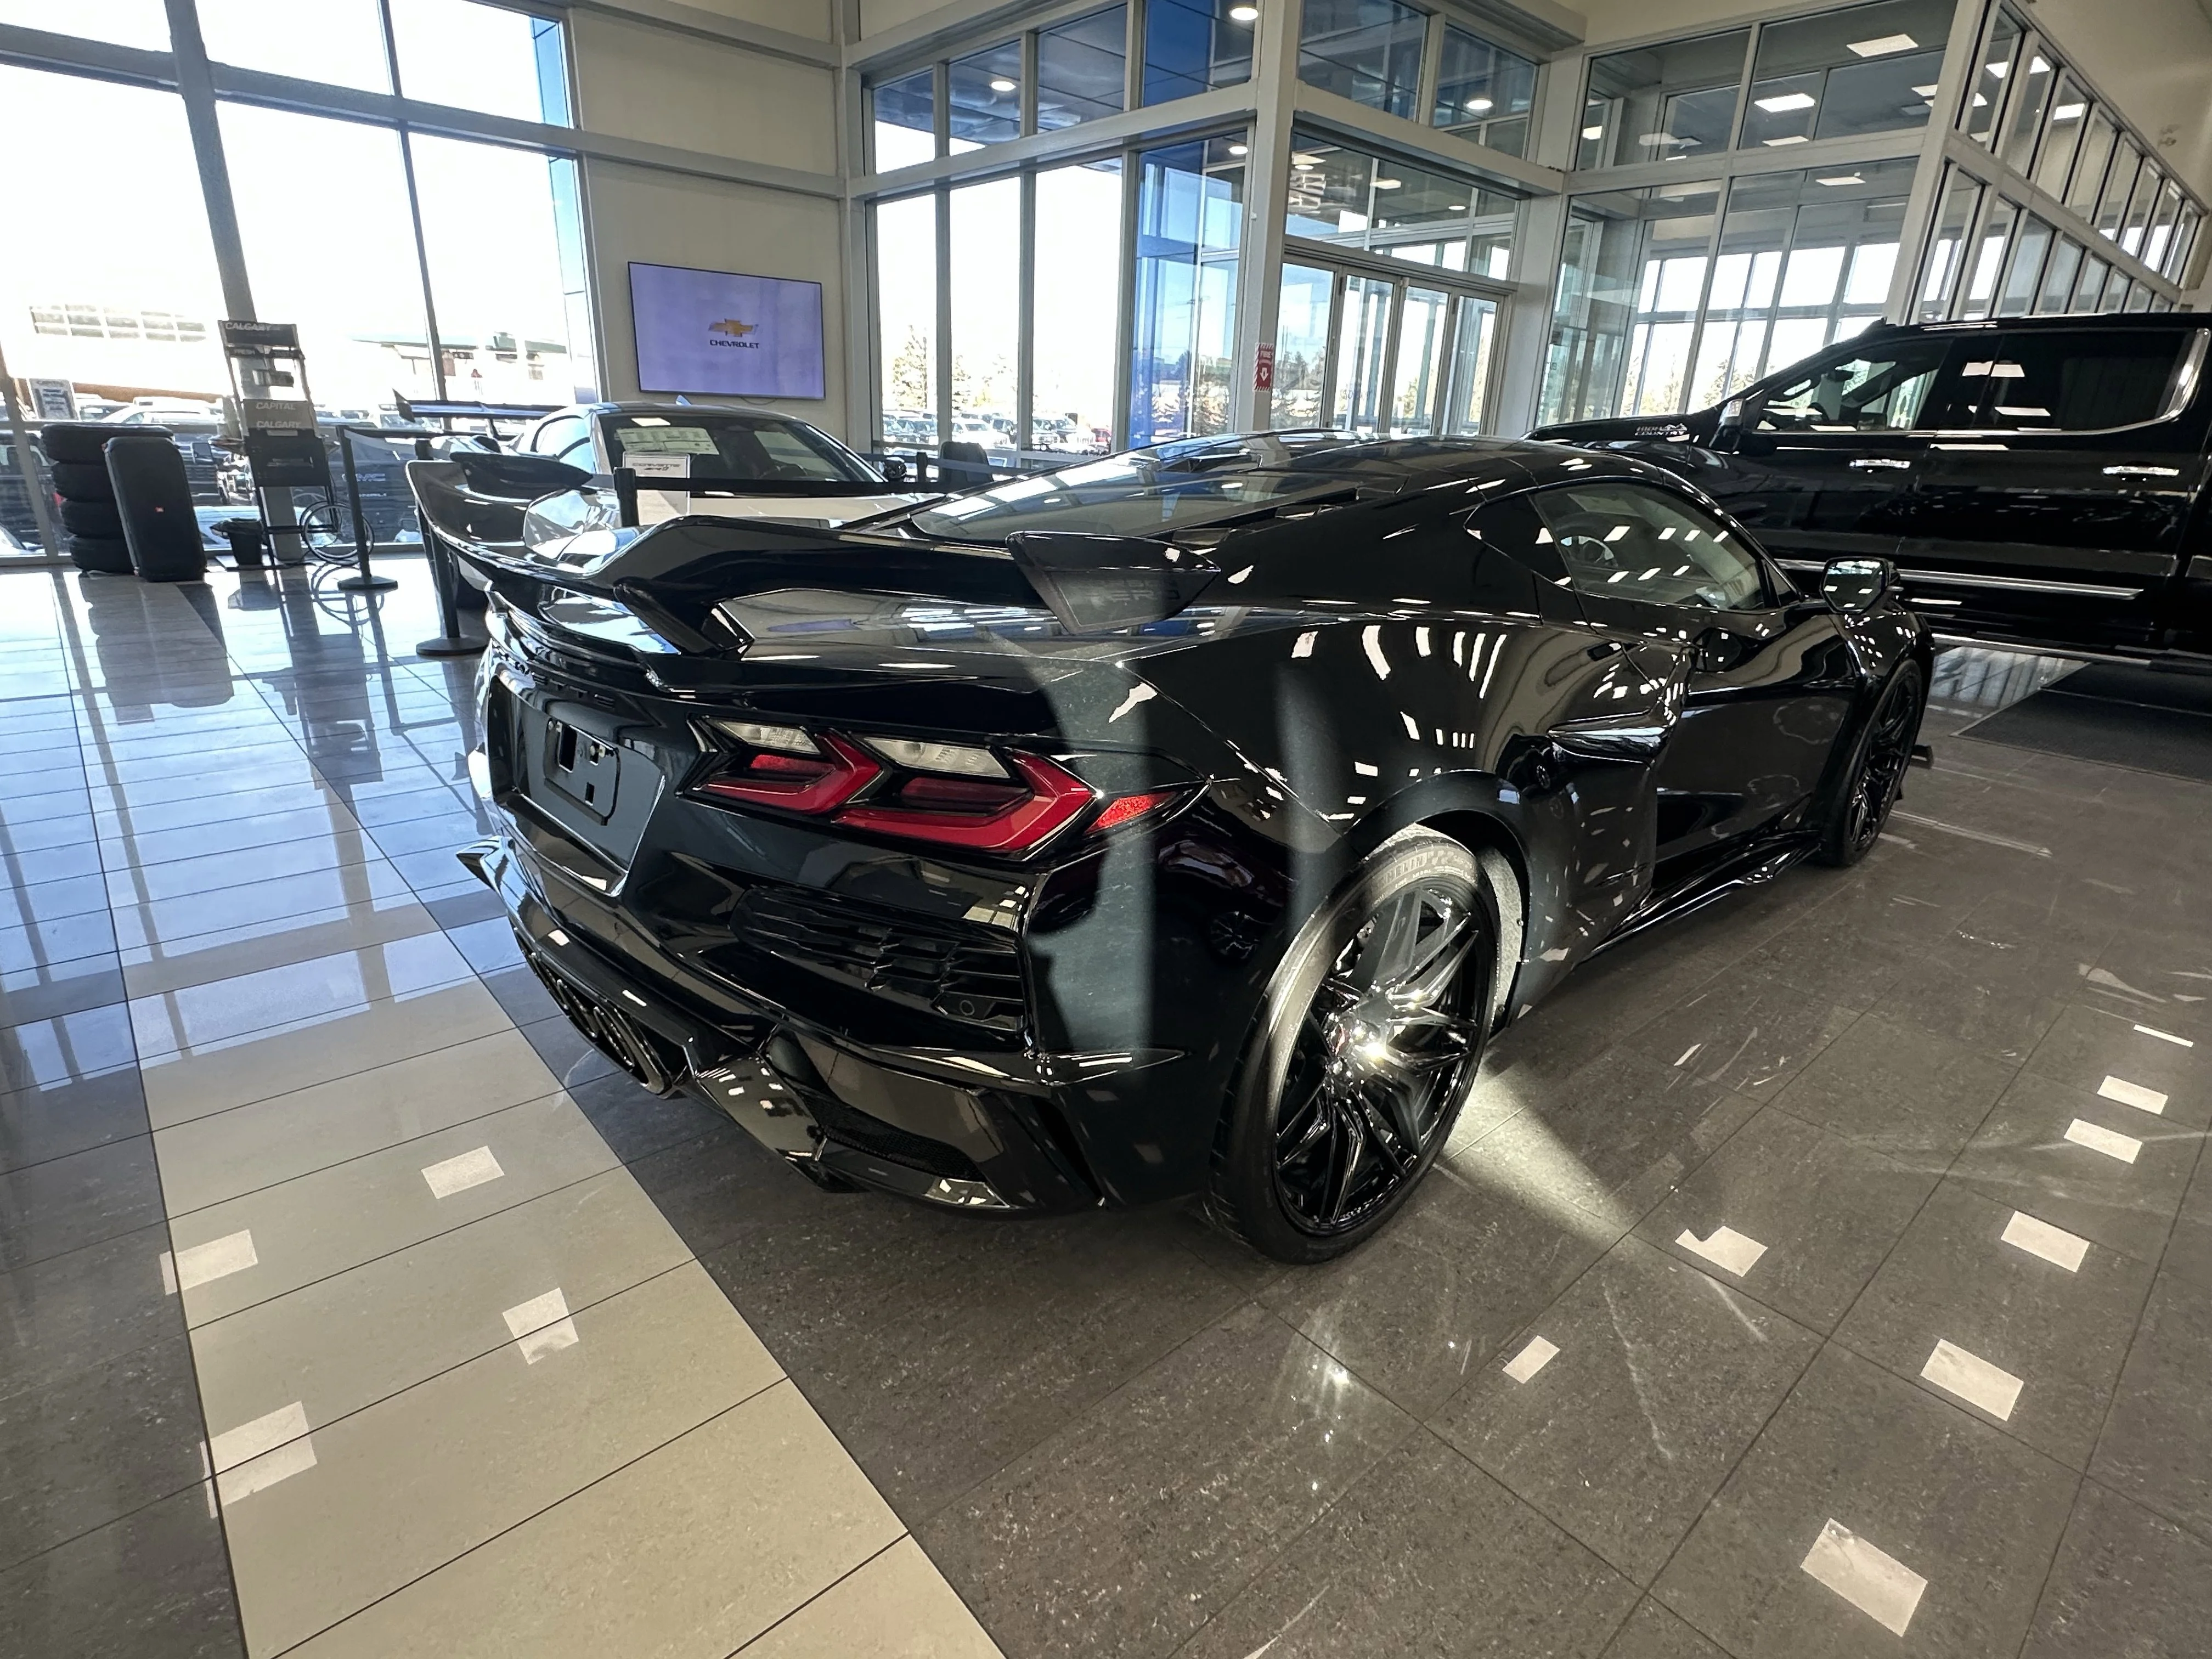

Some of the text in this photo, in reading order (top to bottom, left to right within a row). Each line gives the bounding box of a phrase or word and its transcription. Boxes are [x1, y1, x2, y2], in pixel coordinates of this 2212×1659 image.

[225, 322, 272, 331] CALGARY
[710, 340, 759, 348] CHEVROLET
[256, 402, 296, 410] CAPITAL
[256, 420, 302, 428] CALGARY
